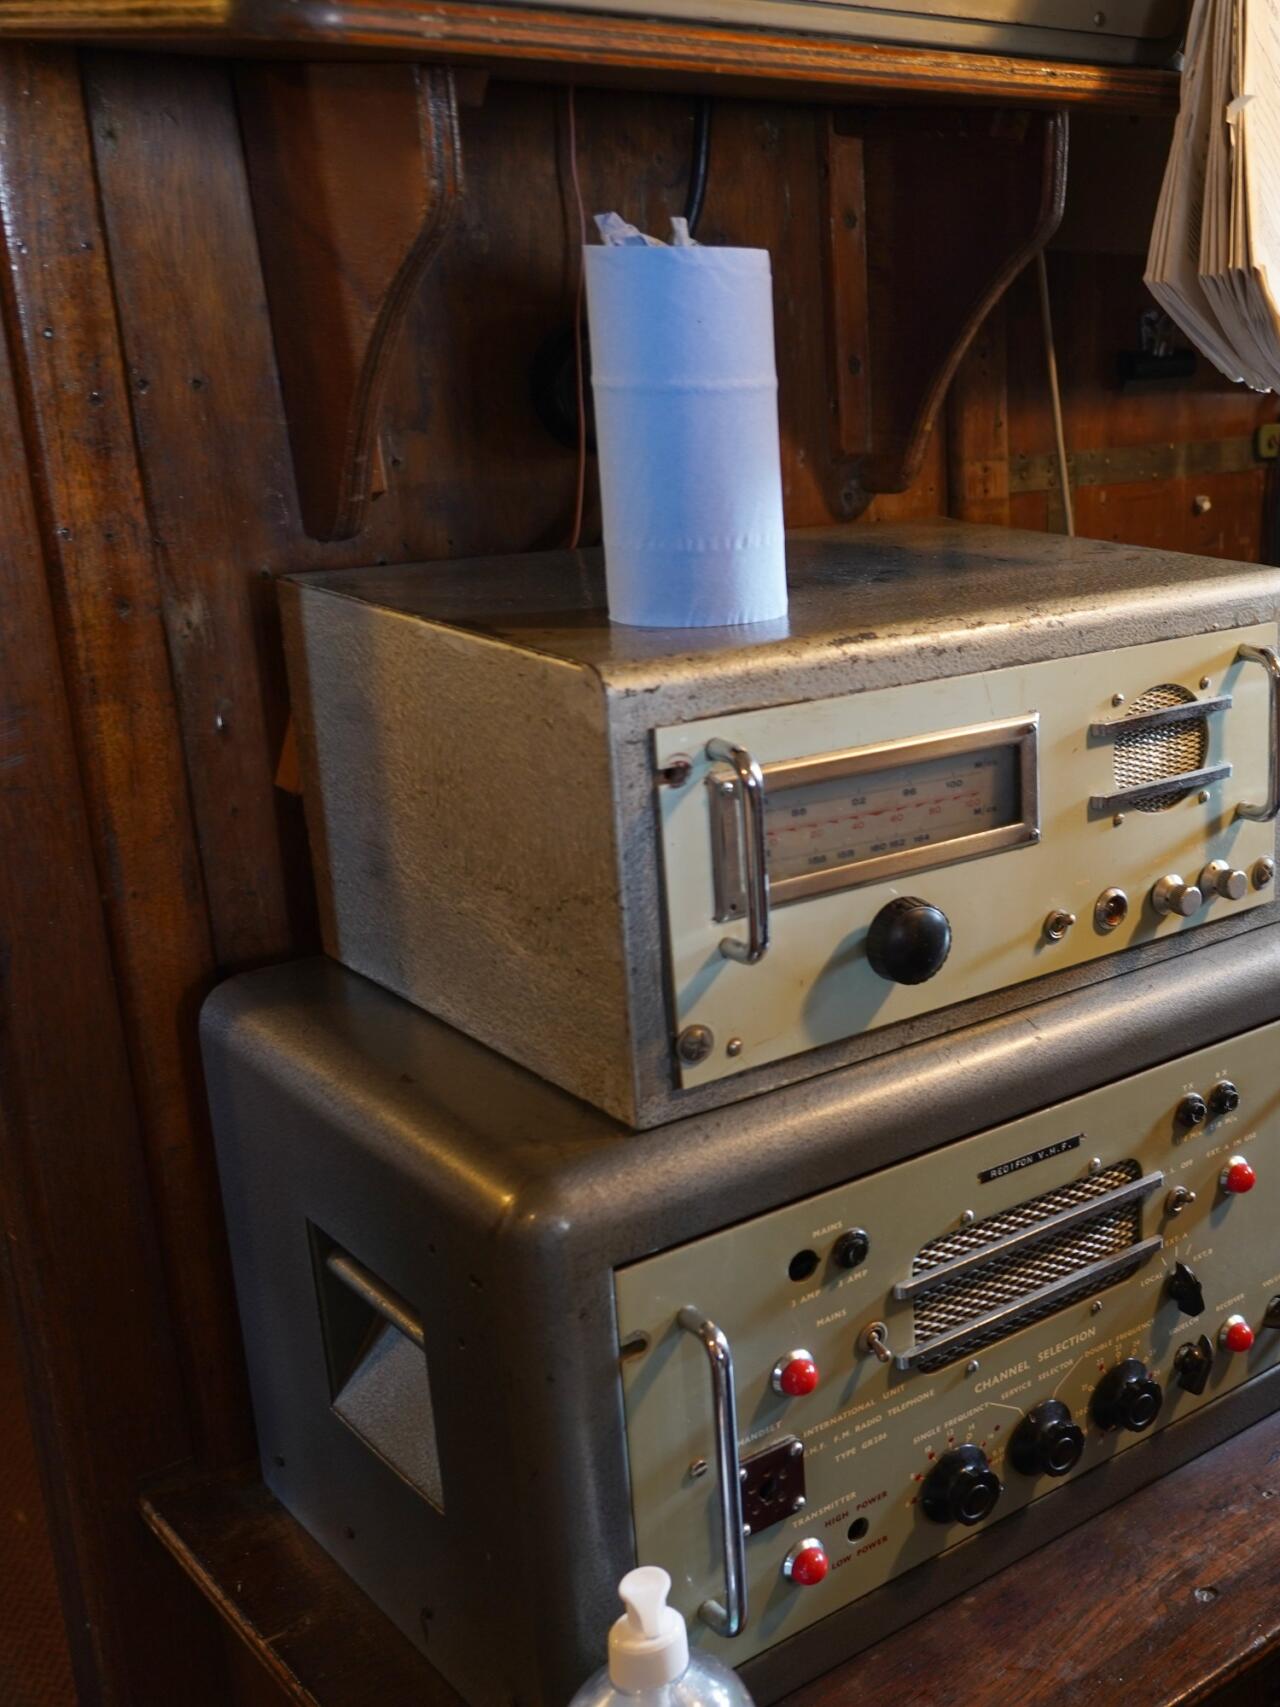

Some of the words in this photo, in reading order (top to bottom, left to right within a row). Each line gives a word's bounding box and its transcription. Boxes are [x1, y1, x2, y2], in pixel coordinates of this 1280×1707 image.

[811, 1221, 843, 1239] MAINS
[846, 1269, 869, 1284] AMP
[1140, 1273, 1164, 1288] LOCAL
[800, 1289, 822, 1304] AMP
[816, 1309, 848, 1328] MAINS
[1084, 1339, 1114, 1359] DOUBLE
[1115, 1318, 1155, 1342] FREQUENCY
[973, 1360, 1032, 1395] CHANNEL
[1036, 1326, 1097, 1364] SELECTION
[1000, 1380, 1033, 1401] SERVICE
[1037, 1358, 1076, 1381] SELECTOR
[802, 1400, 876, 1438] INTERNATIONAL
[882, 1384, 906, 1400] UNIT
[854, 1414, 883, 1433] RADIO
[886, 1389, 936, 1416] TELEPHONE
[912, 1425, 943, 1446] SINGLE
[943, 1402, 989, 1429] FREQUENCY
[834, 1447, 857, 1463] TYPE
[791, 1491, 857, 1529] TRANSMITTER
[824, 1510, 850, 1529] HIGH
[855, 1490, 888, 1512] POWER
[830, 1555, 852, 1571] LOW
[855, 1534, 889, 1557] POWER
